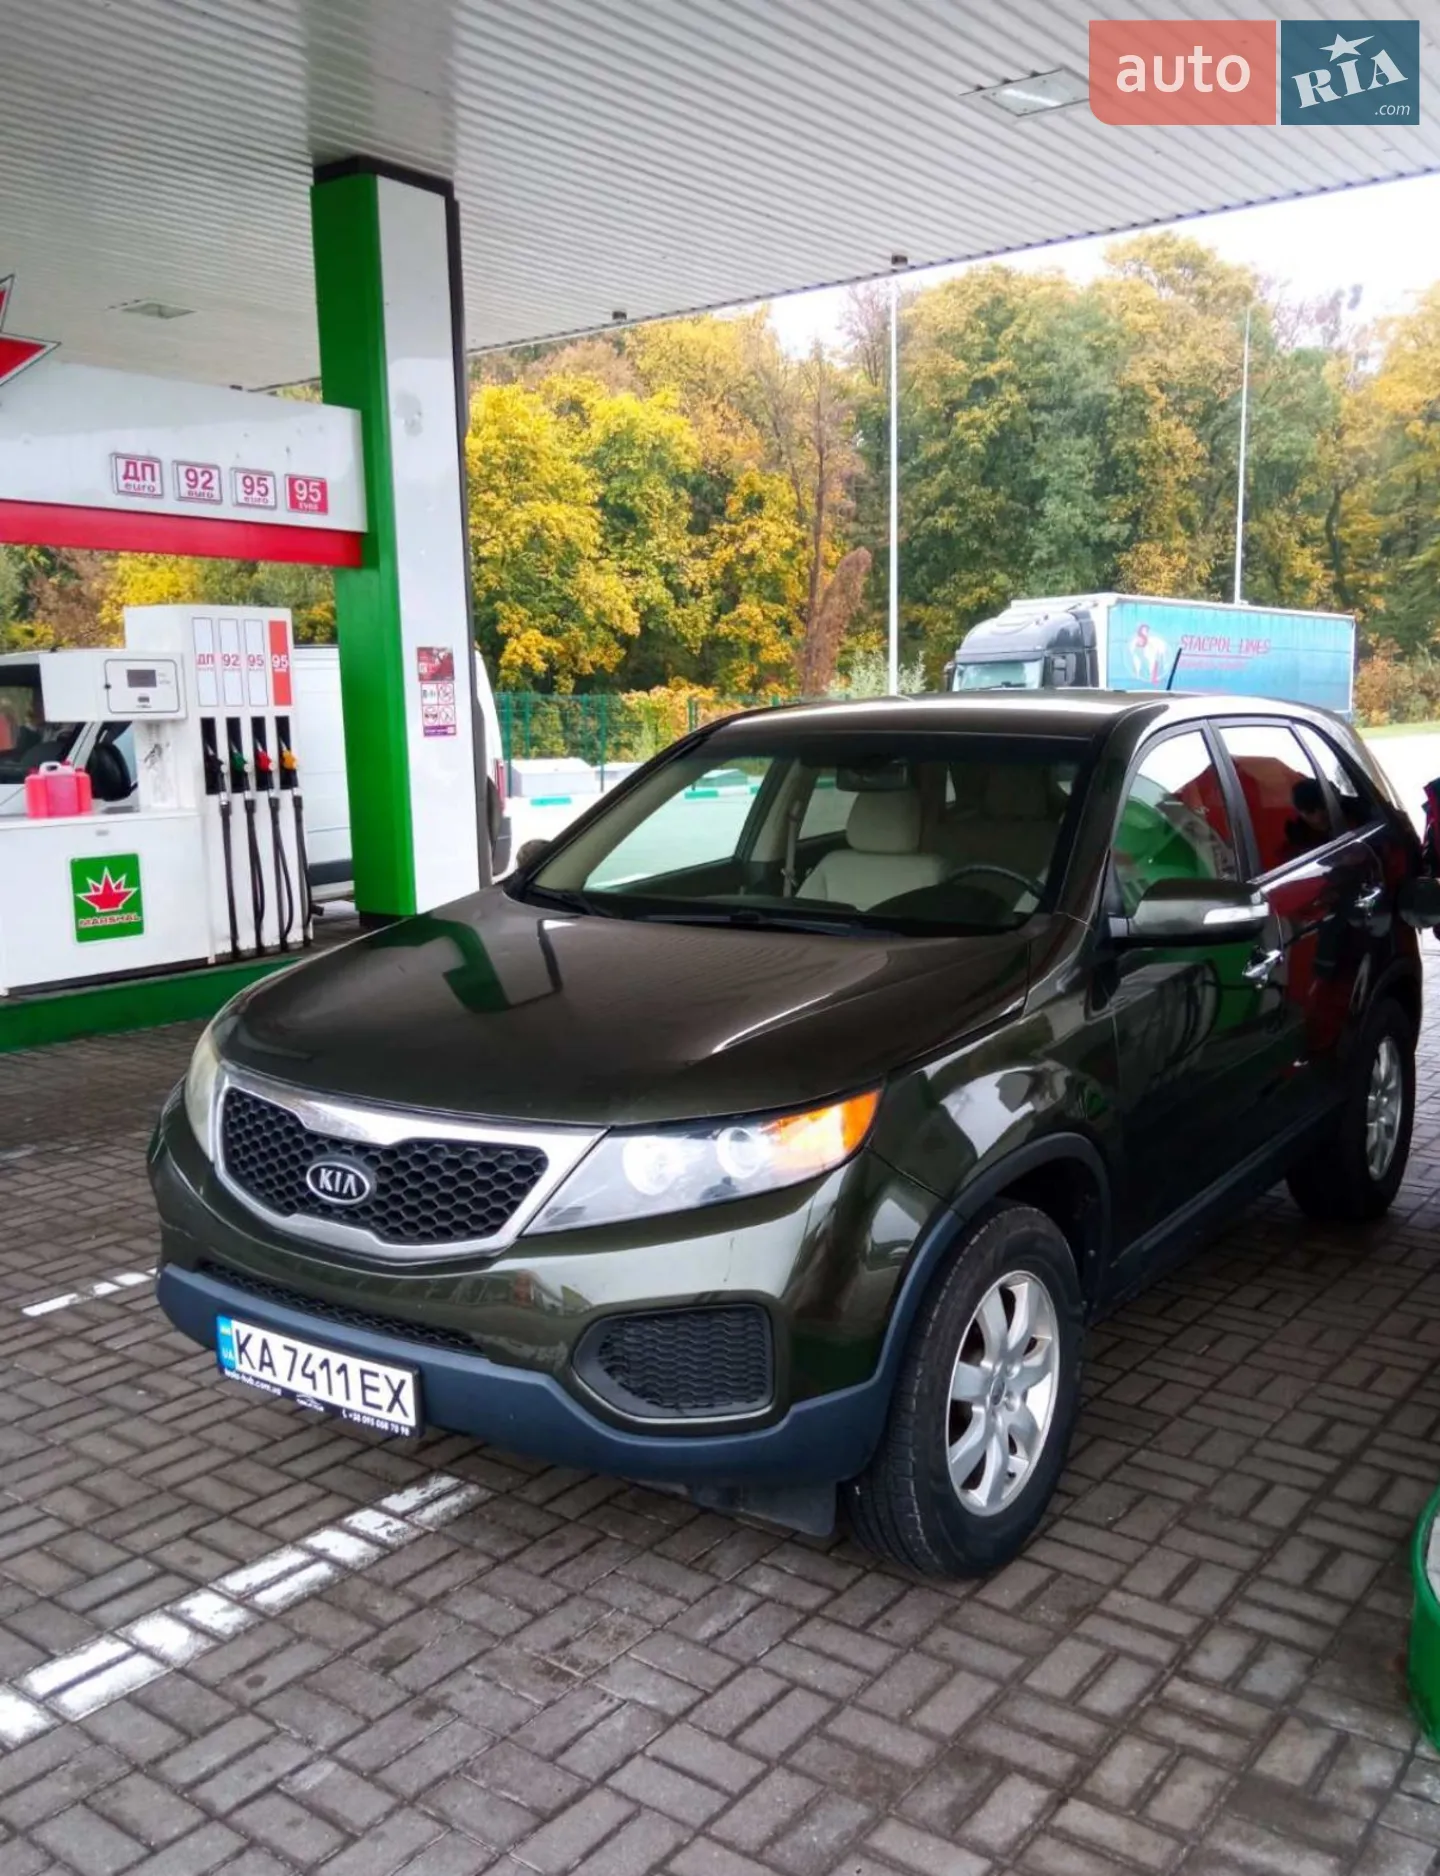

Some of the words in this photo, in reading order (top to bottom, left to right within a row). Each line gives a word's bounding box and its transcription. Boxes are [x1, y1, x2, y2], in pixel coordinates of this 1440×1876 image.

[123, 460, 156, 482] ДП
[185, 468, 215, 491] 92
[124, 482, 156, 494] euro
[187, 489, 215, 500] euro
[242, 475, 269, 498] 95
[294, 479, 322, 503] 95
[1136, 624, 1150, 648] S
[1239, 638, 1271, 655] LINES
[222, 654, 241, 668] 92
[247, 654, 265, 668] 95
[271, 654, 289, 669] 95
[319, 1168, 358, 1197] KIA
